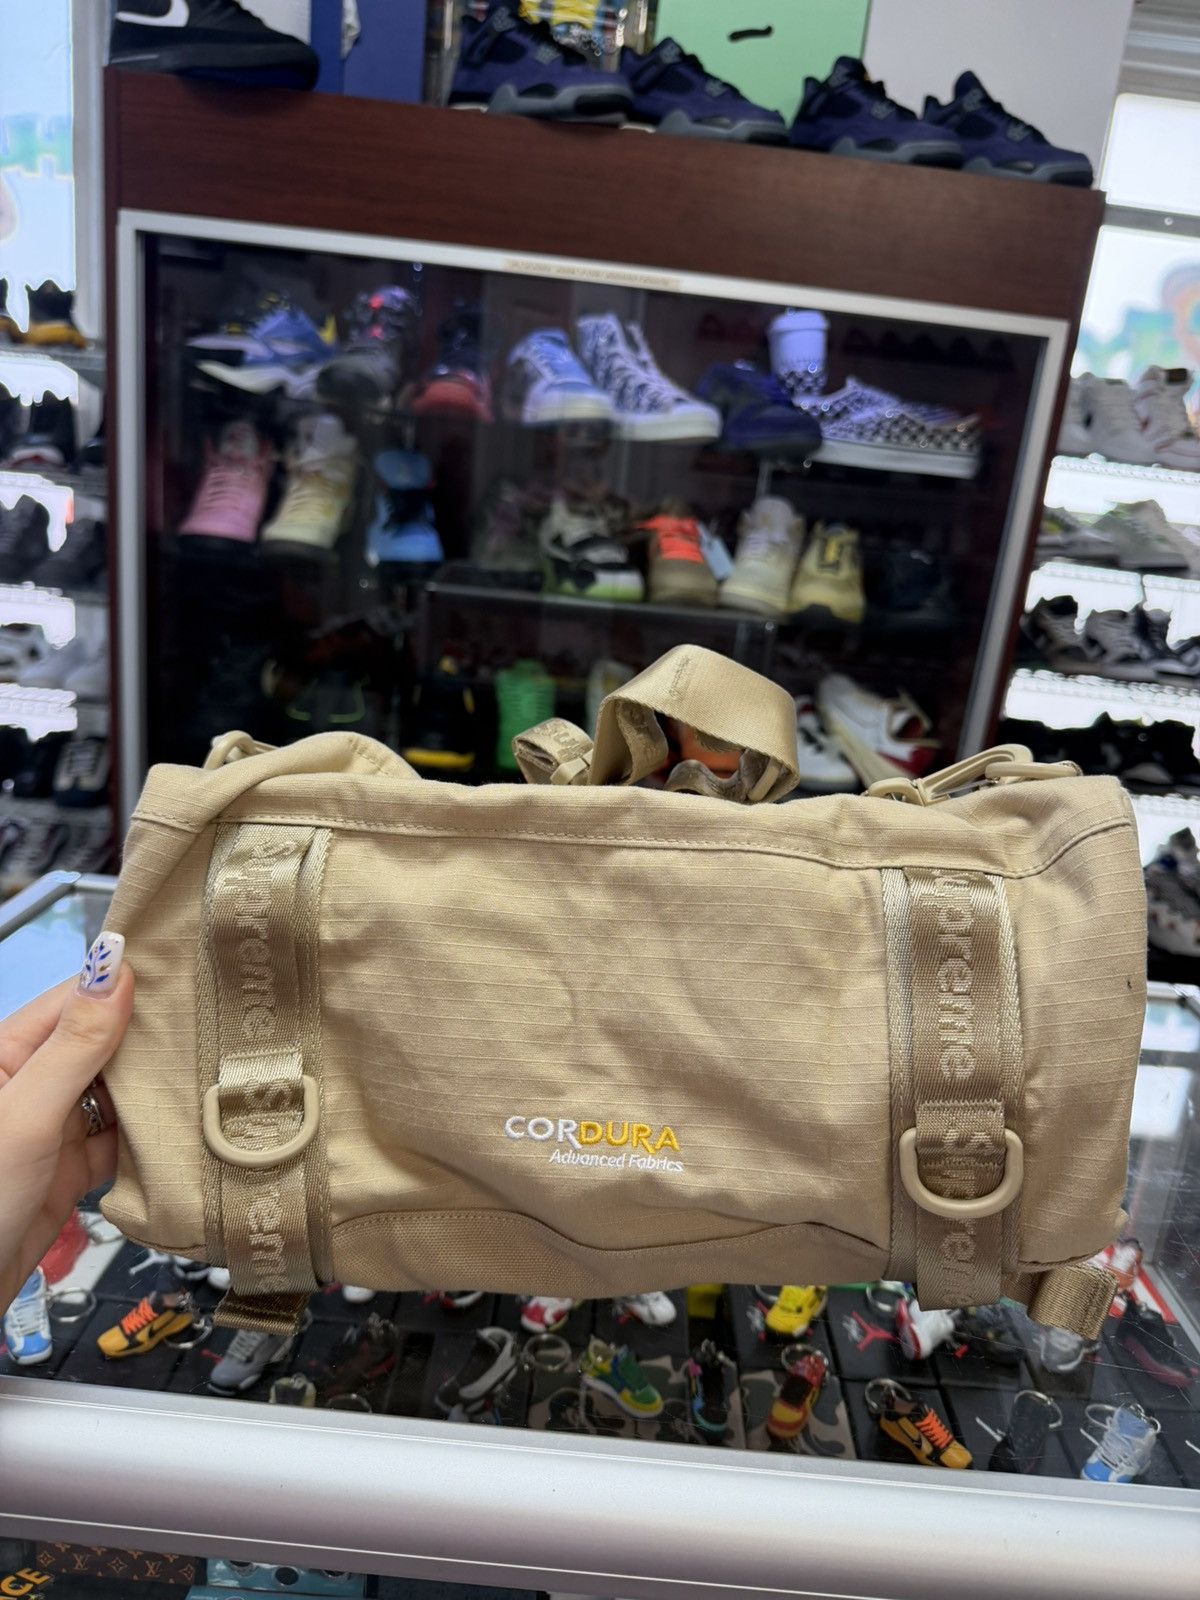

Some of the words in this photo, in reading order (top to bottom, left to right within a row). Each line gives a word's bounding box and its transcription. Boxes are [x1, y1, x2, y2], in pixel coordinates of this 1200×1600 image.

[919, 875, 977, 1079] upreme
[505, 1115, 680, 1154] CORDURA
[549, 1149, 627, 1168] Advanced
[628, 1154, 684, 1173] Fabrics
